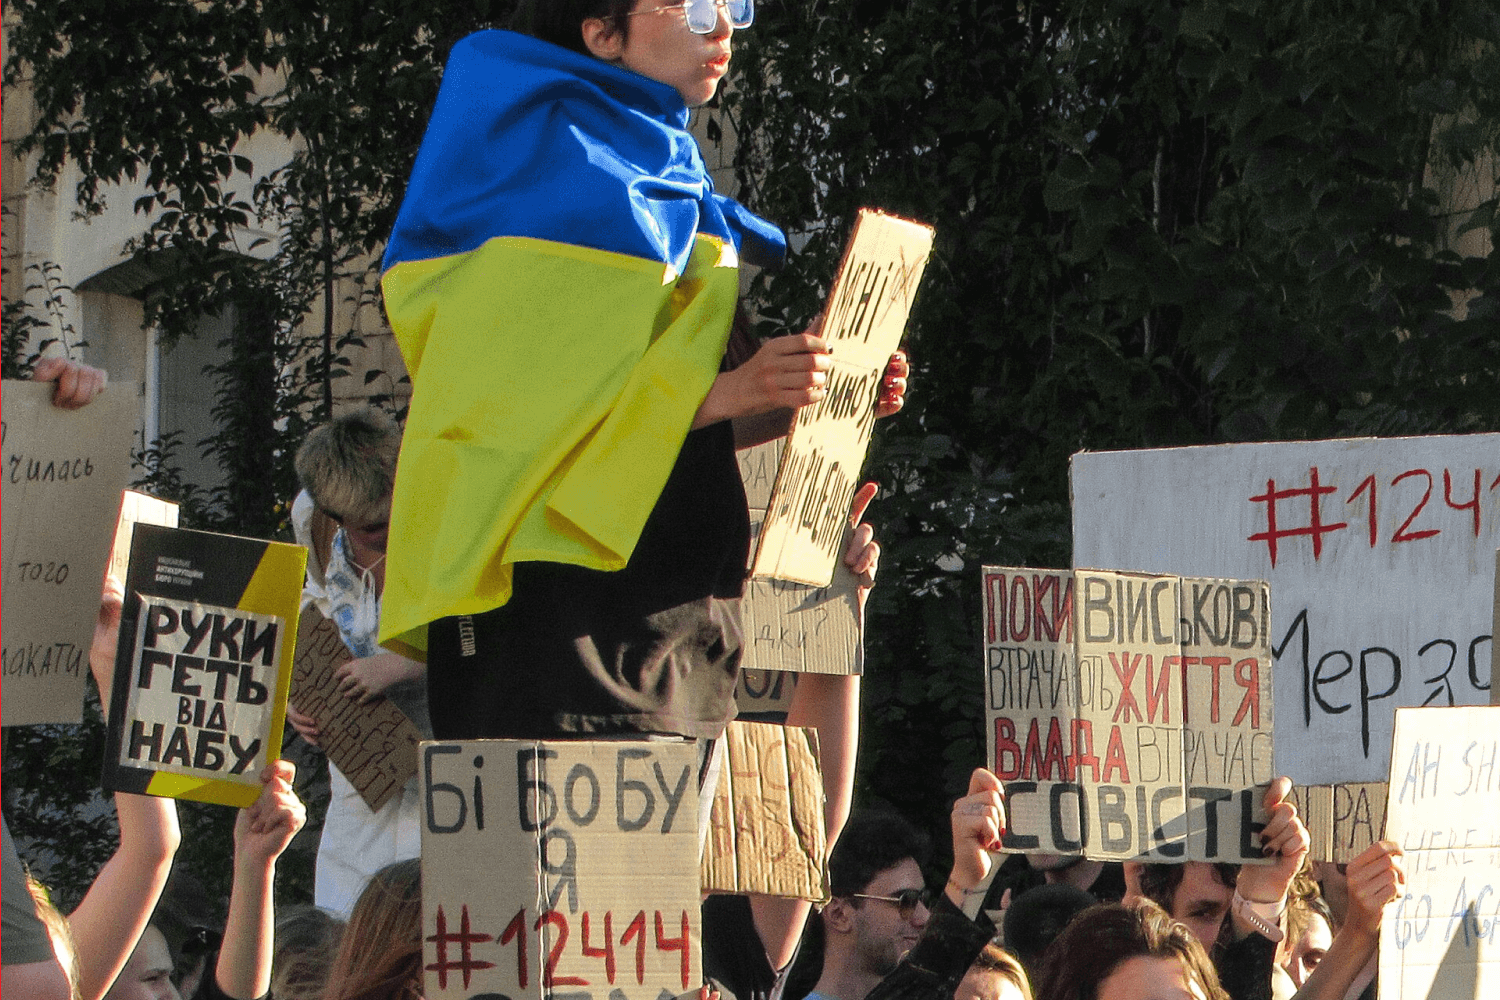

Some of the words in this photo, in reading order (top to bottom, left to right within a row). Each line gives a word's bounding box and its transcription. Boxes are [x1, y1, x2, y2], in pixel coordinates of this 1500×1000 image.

[144, 604, 274, 668] РУКИ
[985, 573, 1074, 644] ПОКИ
[138, 650, 269, 706] ГЕТЬ
[1108, 651, 1261, 729] ЖИТТЯ
[128, 721, 262, 775] НАБУ
[177, 697, 227, 732] ВІД
[994, 716, 1130, 784] ВЛАДА
[1136, 725, 1271, 786] ВТРАЧАЄ
[1399, 740, 1442, 805] AH
[1001, 781, 1270, 859] СОВІСТЬ
[540, 827, 579, 915] Я
[424, 902, 691, 992] #12414
[1394, 893, 1432, 950] GO
